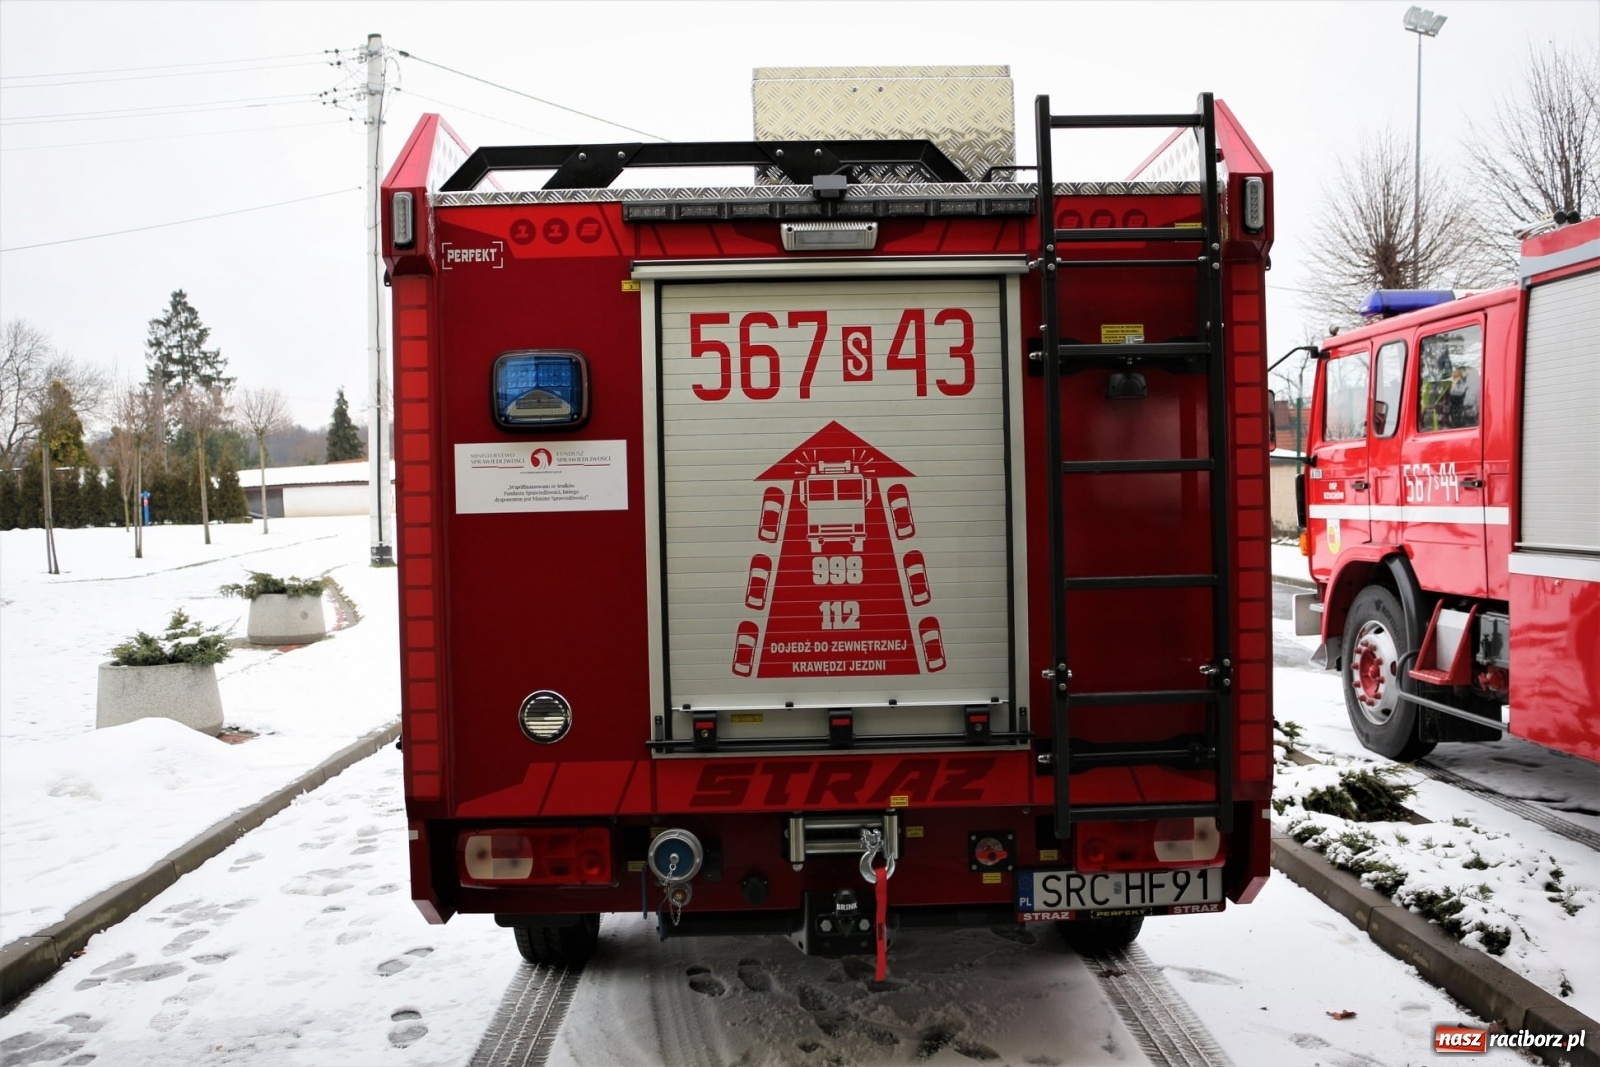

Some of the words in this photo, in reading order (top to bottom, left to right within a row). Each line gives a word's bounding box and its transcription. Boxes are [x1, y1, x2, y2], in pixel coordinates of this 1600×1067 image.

[447, 248, 498, 263] PERFEKT
[690, 310, 828, 401] 567
[887, 308, 975, 397] 43
[1403, 463, 1432, 502] 567
[1439, 462, 1459, 502] 44
[811, 555, 864, 585] 998
[819, 601, 860, 630] 112
[814, 641, 829, 653] DO
[831, 639, 907, 654] ZEWNĘTRZNEJ
[792, 661, 846, 674] KRAWĘDZI
[849, 660, 886, 671] JEZDNI
[1042, 873, 1110, 908] SRC
[1125, 870, 1209, 904] HF91
[1019, 897, 1032, 907] PL
[1096, 909, 1147, 918] PERFEKT
